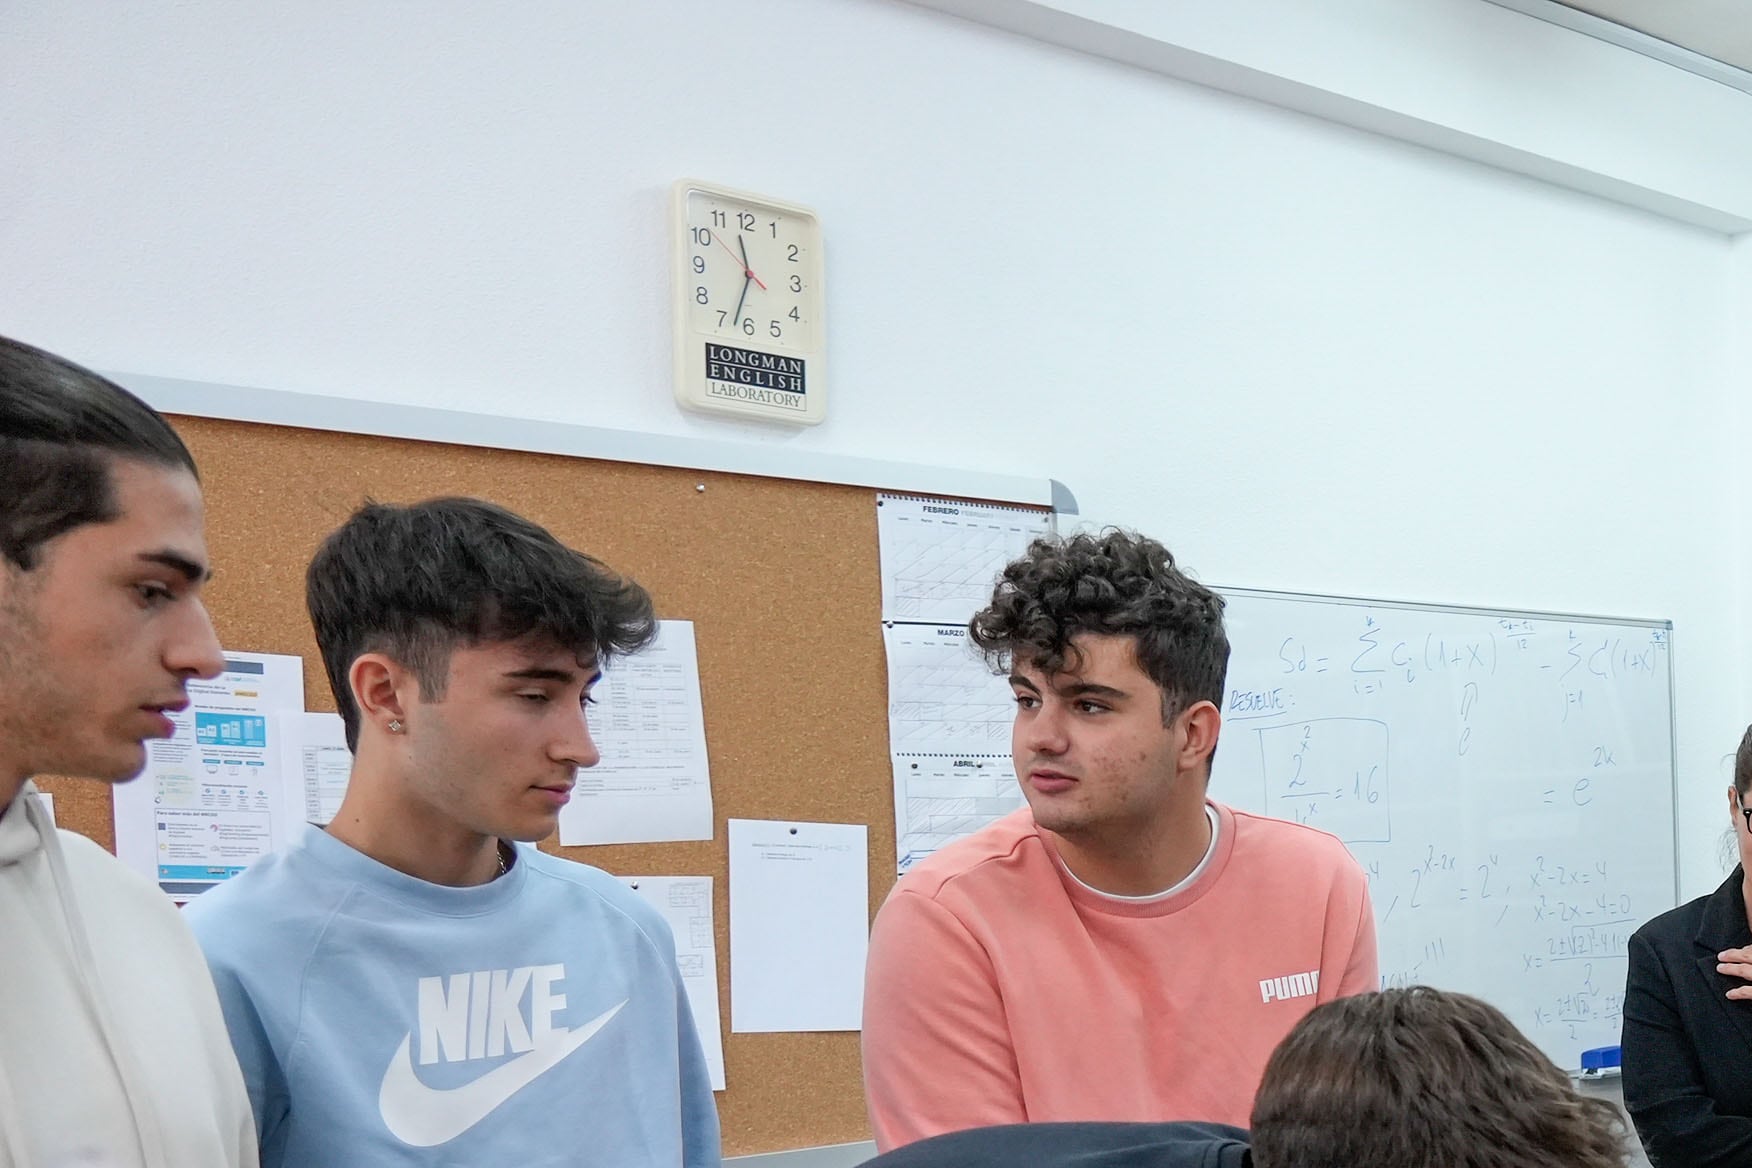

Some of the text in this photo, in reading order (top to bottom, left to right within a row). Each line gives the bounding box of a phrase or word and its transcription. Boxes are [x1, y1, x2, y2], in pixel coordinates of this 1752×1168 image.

[711, 210, 726, 228] 11
[736, 212, 755, 232] 12
[691, 226, 711, 246] 10
[769, 222, 776, 239] 1
[787, 244, 799, 262] 2
[693, 255, 705, 273] 9
[789, 275, 801, 293] 3
[696, 286, 708, 305] 8
[716, 310, 727, 327] 7
[789, 306, 800, 322] 4
[743, 317, 755, 336] 6
[769, 320, 782, 337] 5
[709, 345, 801, 373] LONGMAN
[710, 363, 801, 391] ENGLISH
[711, 381, 801, 407] LABORATORY
[923, 505, 960, 516] FEBRERO
[937, 629, 965, 637] MARZO
[953, 760, 975, 768] ABRIL
[418, 963, 569, 1065] NIKE
